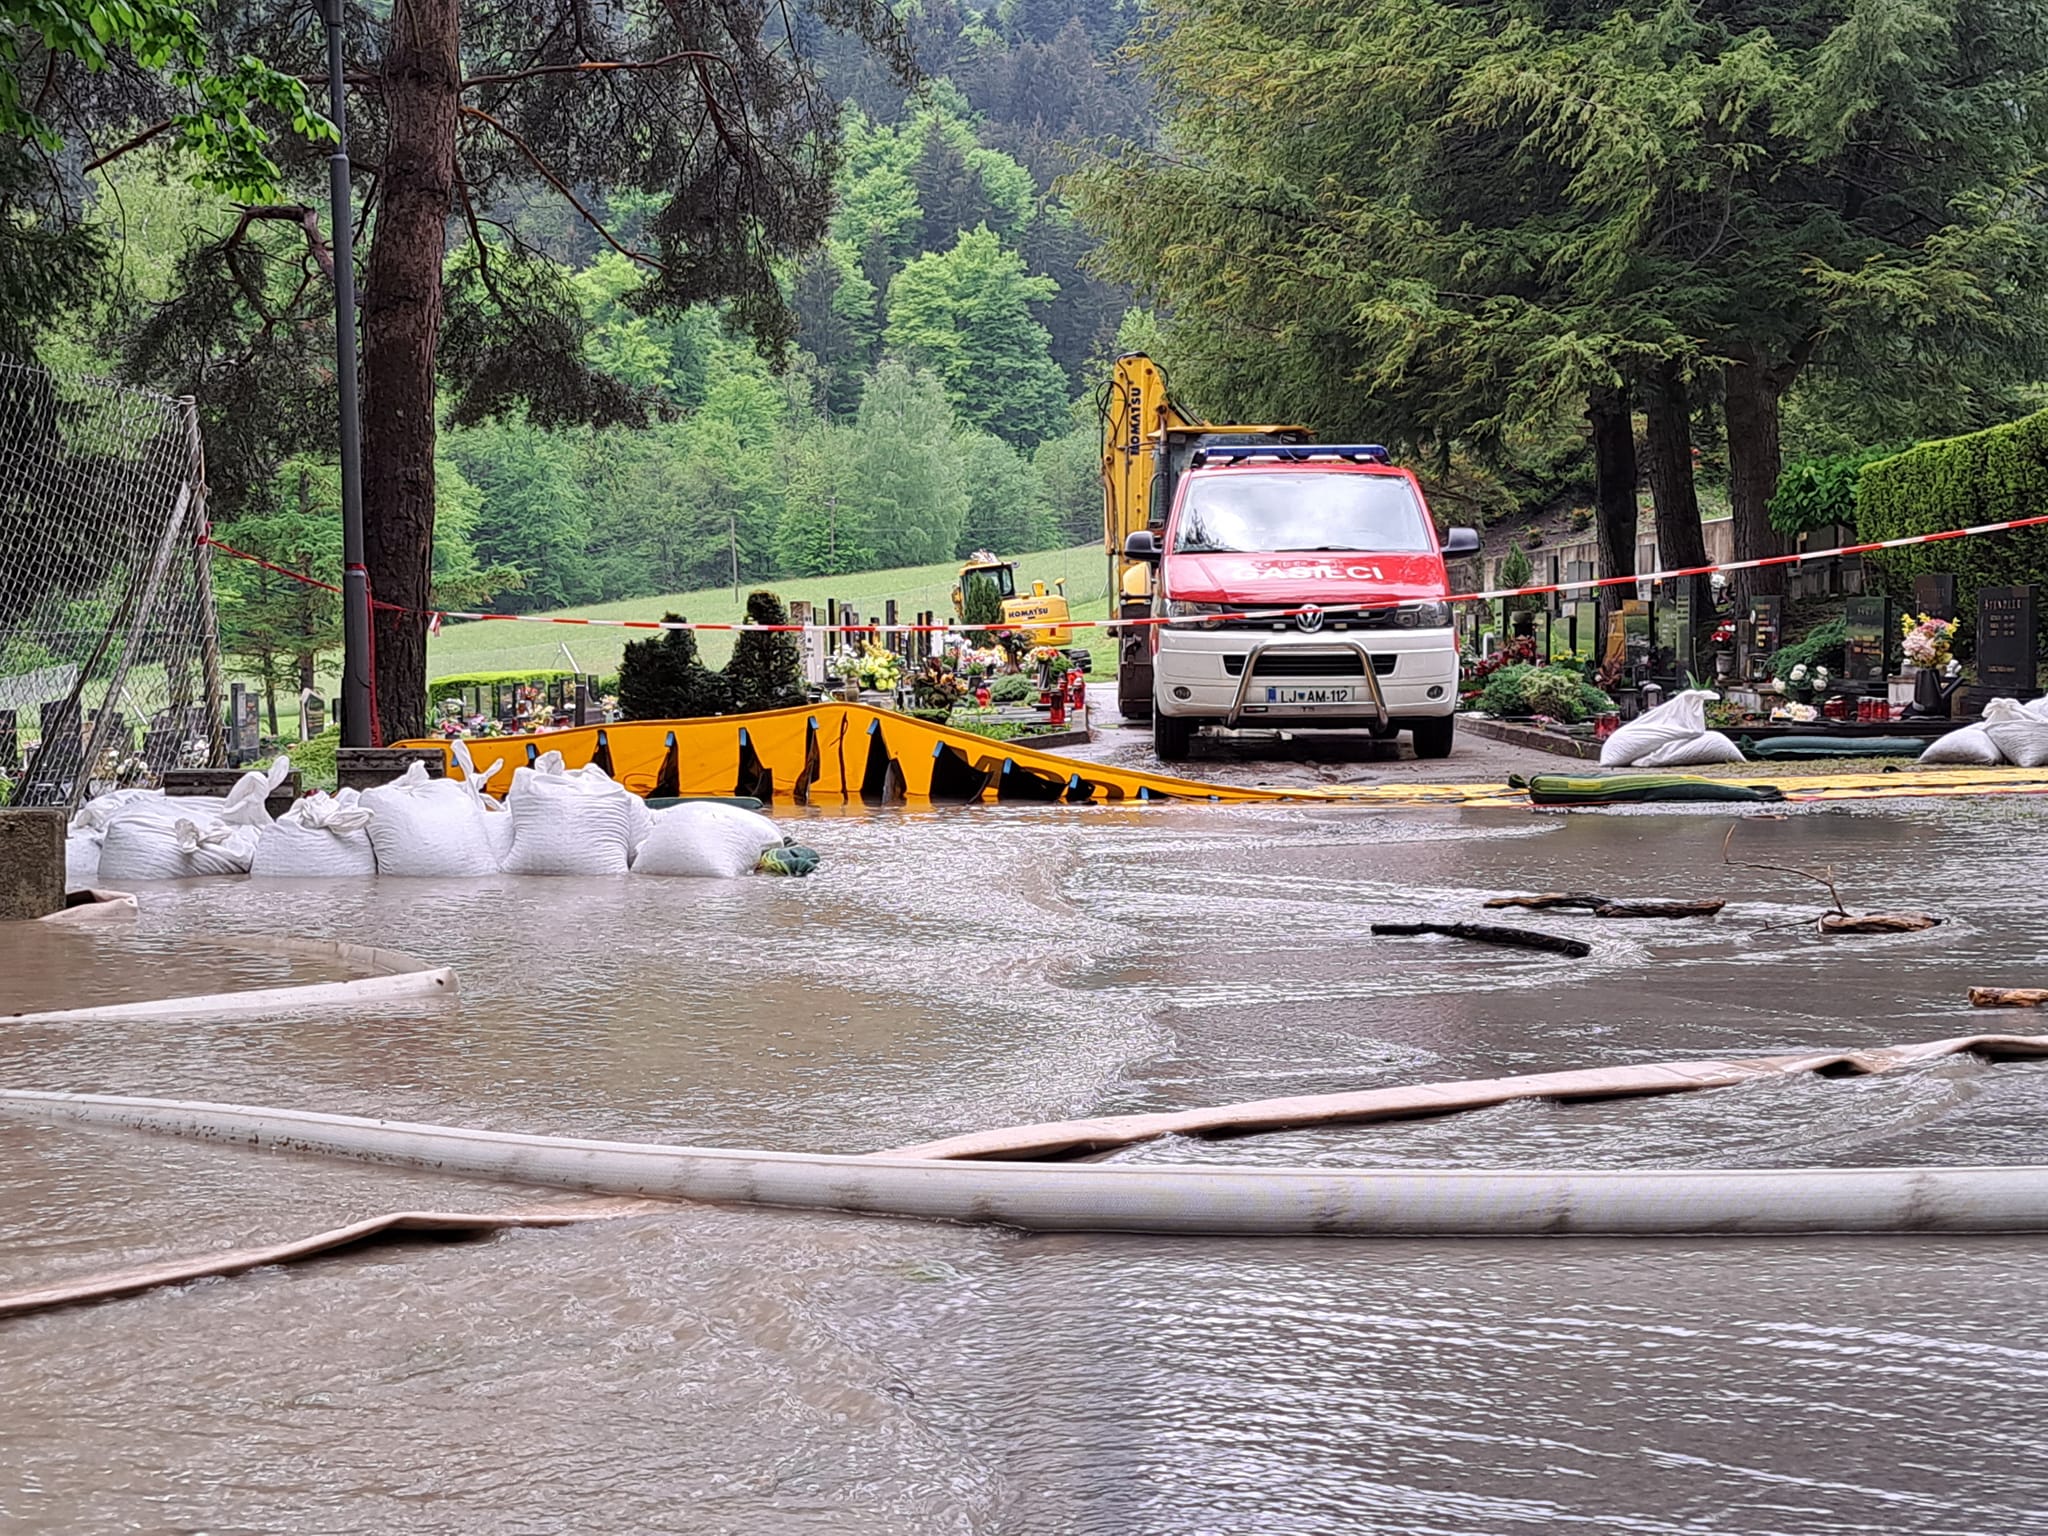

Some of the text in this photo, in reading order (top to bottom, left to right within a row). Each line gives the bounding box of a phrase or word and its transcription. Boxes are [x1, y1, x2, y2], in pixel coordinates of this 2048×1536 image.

[1008, 607, 1049, 619] KOMATSU
[1280, 689, 1348, 703] LJ AM-112
